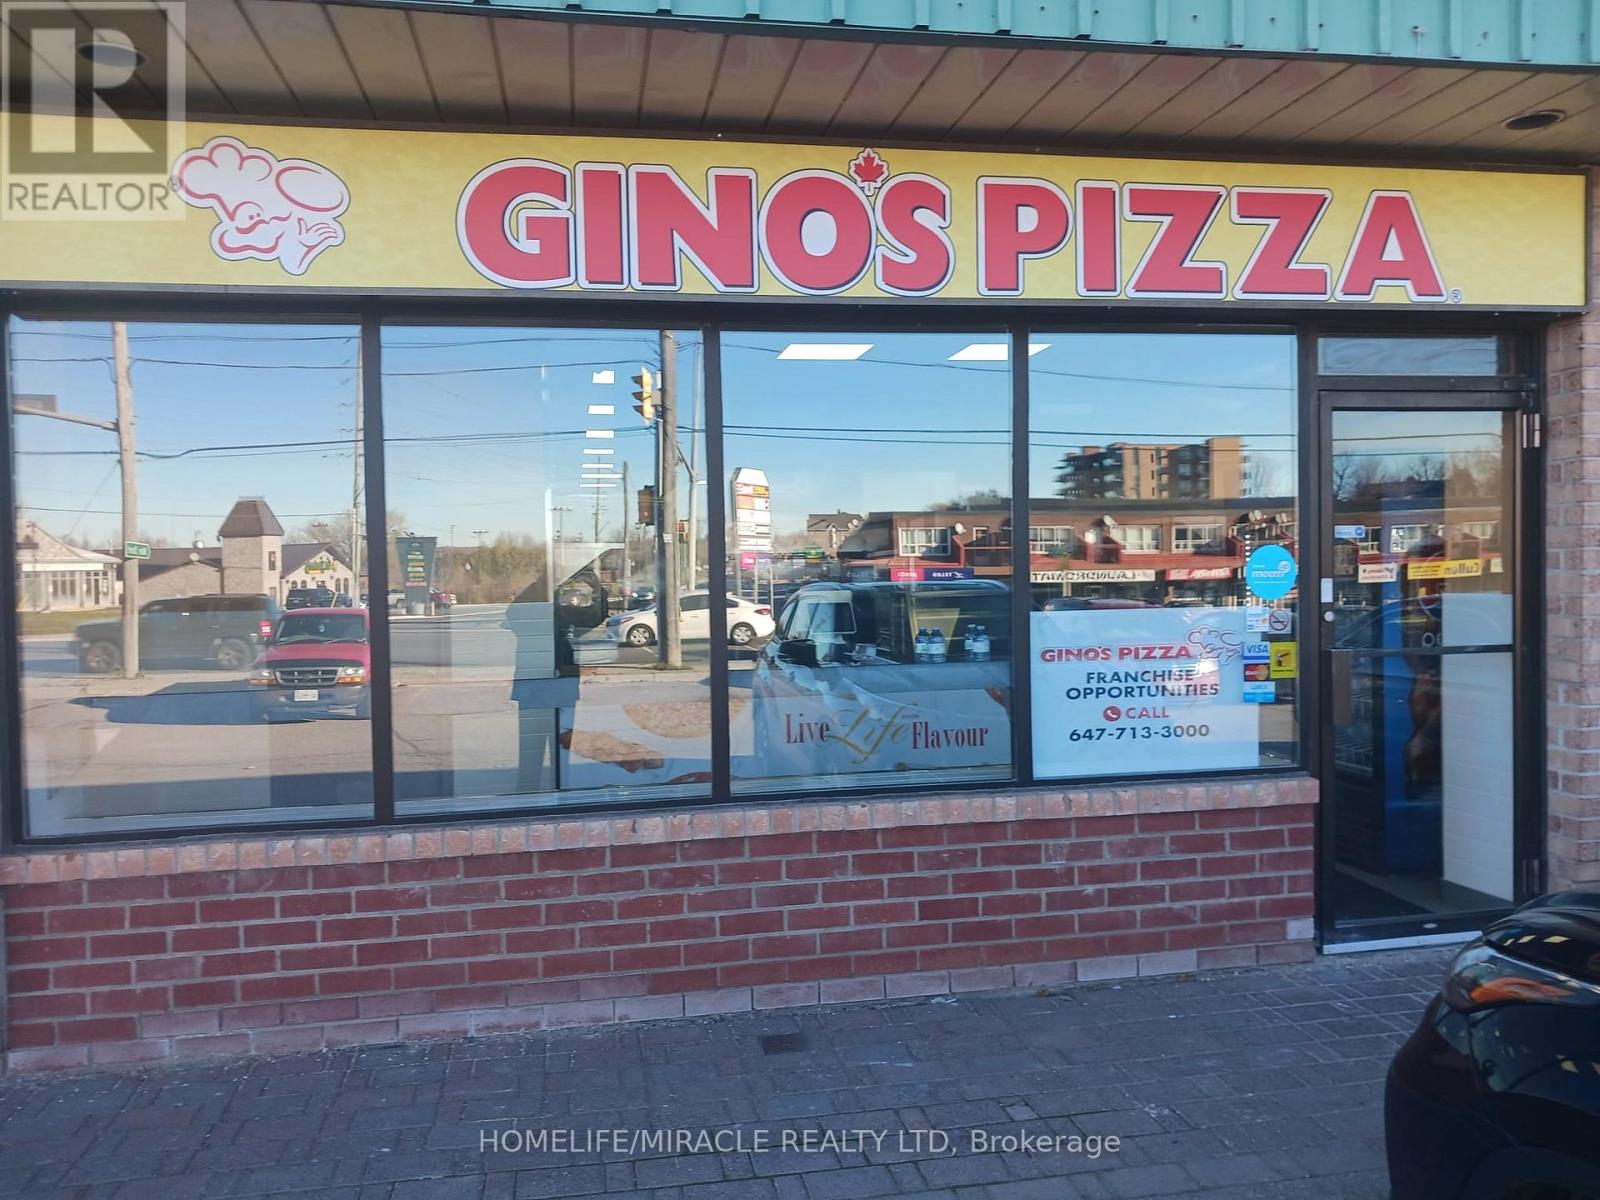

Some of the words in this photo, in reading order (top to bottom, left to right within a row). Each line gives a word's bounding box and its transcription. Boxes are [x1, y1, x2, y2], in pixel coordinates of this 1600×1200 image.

[977, 176, 1450, 305] PIZZA
[1118, 645, 1192, 660] PIZZA
[1247, 644, 1268, 653] VISA
[1086, 669, 1194, 684] FRANCHISE
[1066, 683, 1220, 701] OPPORTUNITIES
[1125, 707, 1170, 719] CALL
[784, 714, 830, 744] Live
[911, 721, 989, 750] Flavour
[1069, 724, 1210, 742] 647-713-3000
